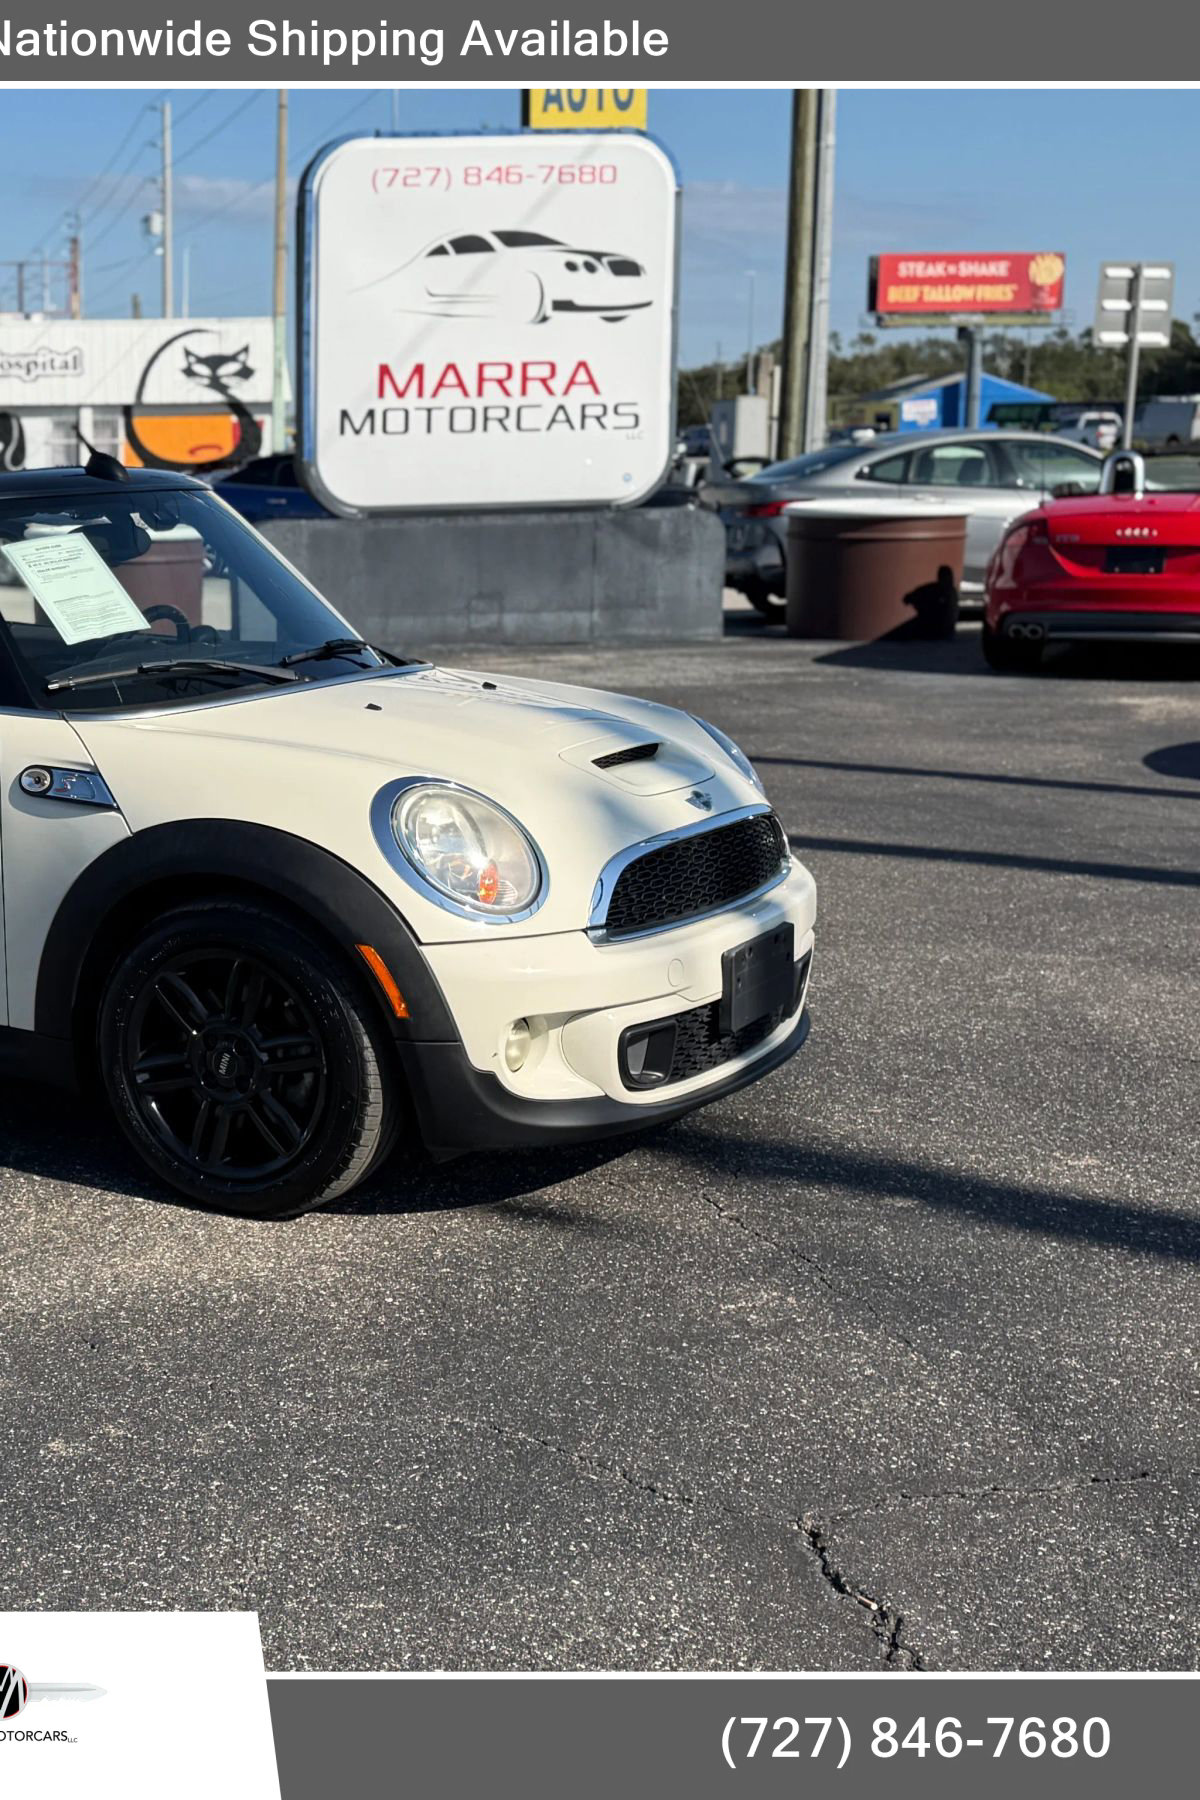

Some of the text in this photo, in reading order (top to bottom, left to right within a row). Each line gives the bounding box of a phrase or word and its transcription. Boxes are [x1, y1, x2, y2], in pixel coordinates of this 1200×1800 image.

[371, 165, 618, 193] (727) 846-7680
[897, 261, 947, 277] STEAK
[958, 261, 1009, 277] SHAKE
[378, 360, 601, 399] MARRA
[339, 402, 640, 436] MOTORCARS
[218, 1052, 230, 1075] MINI
